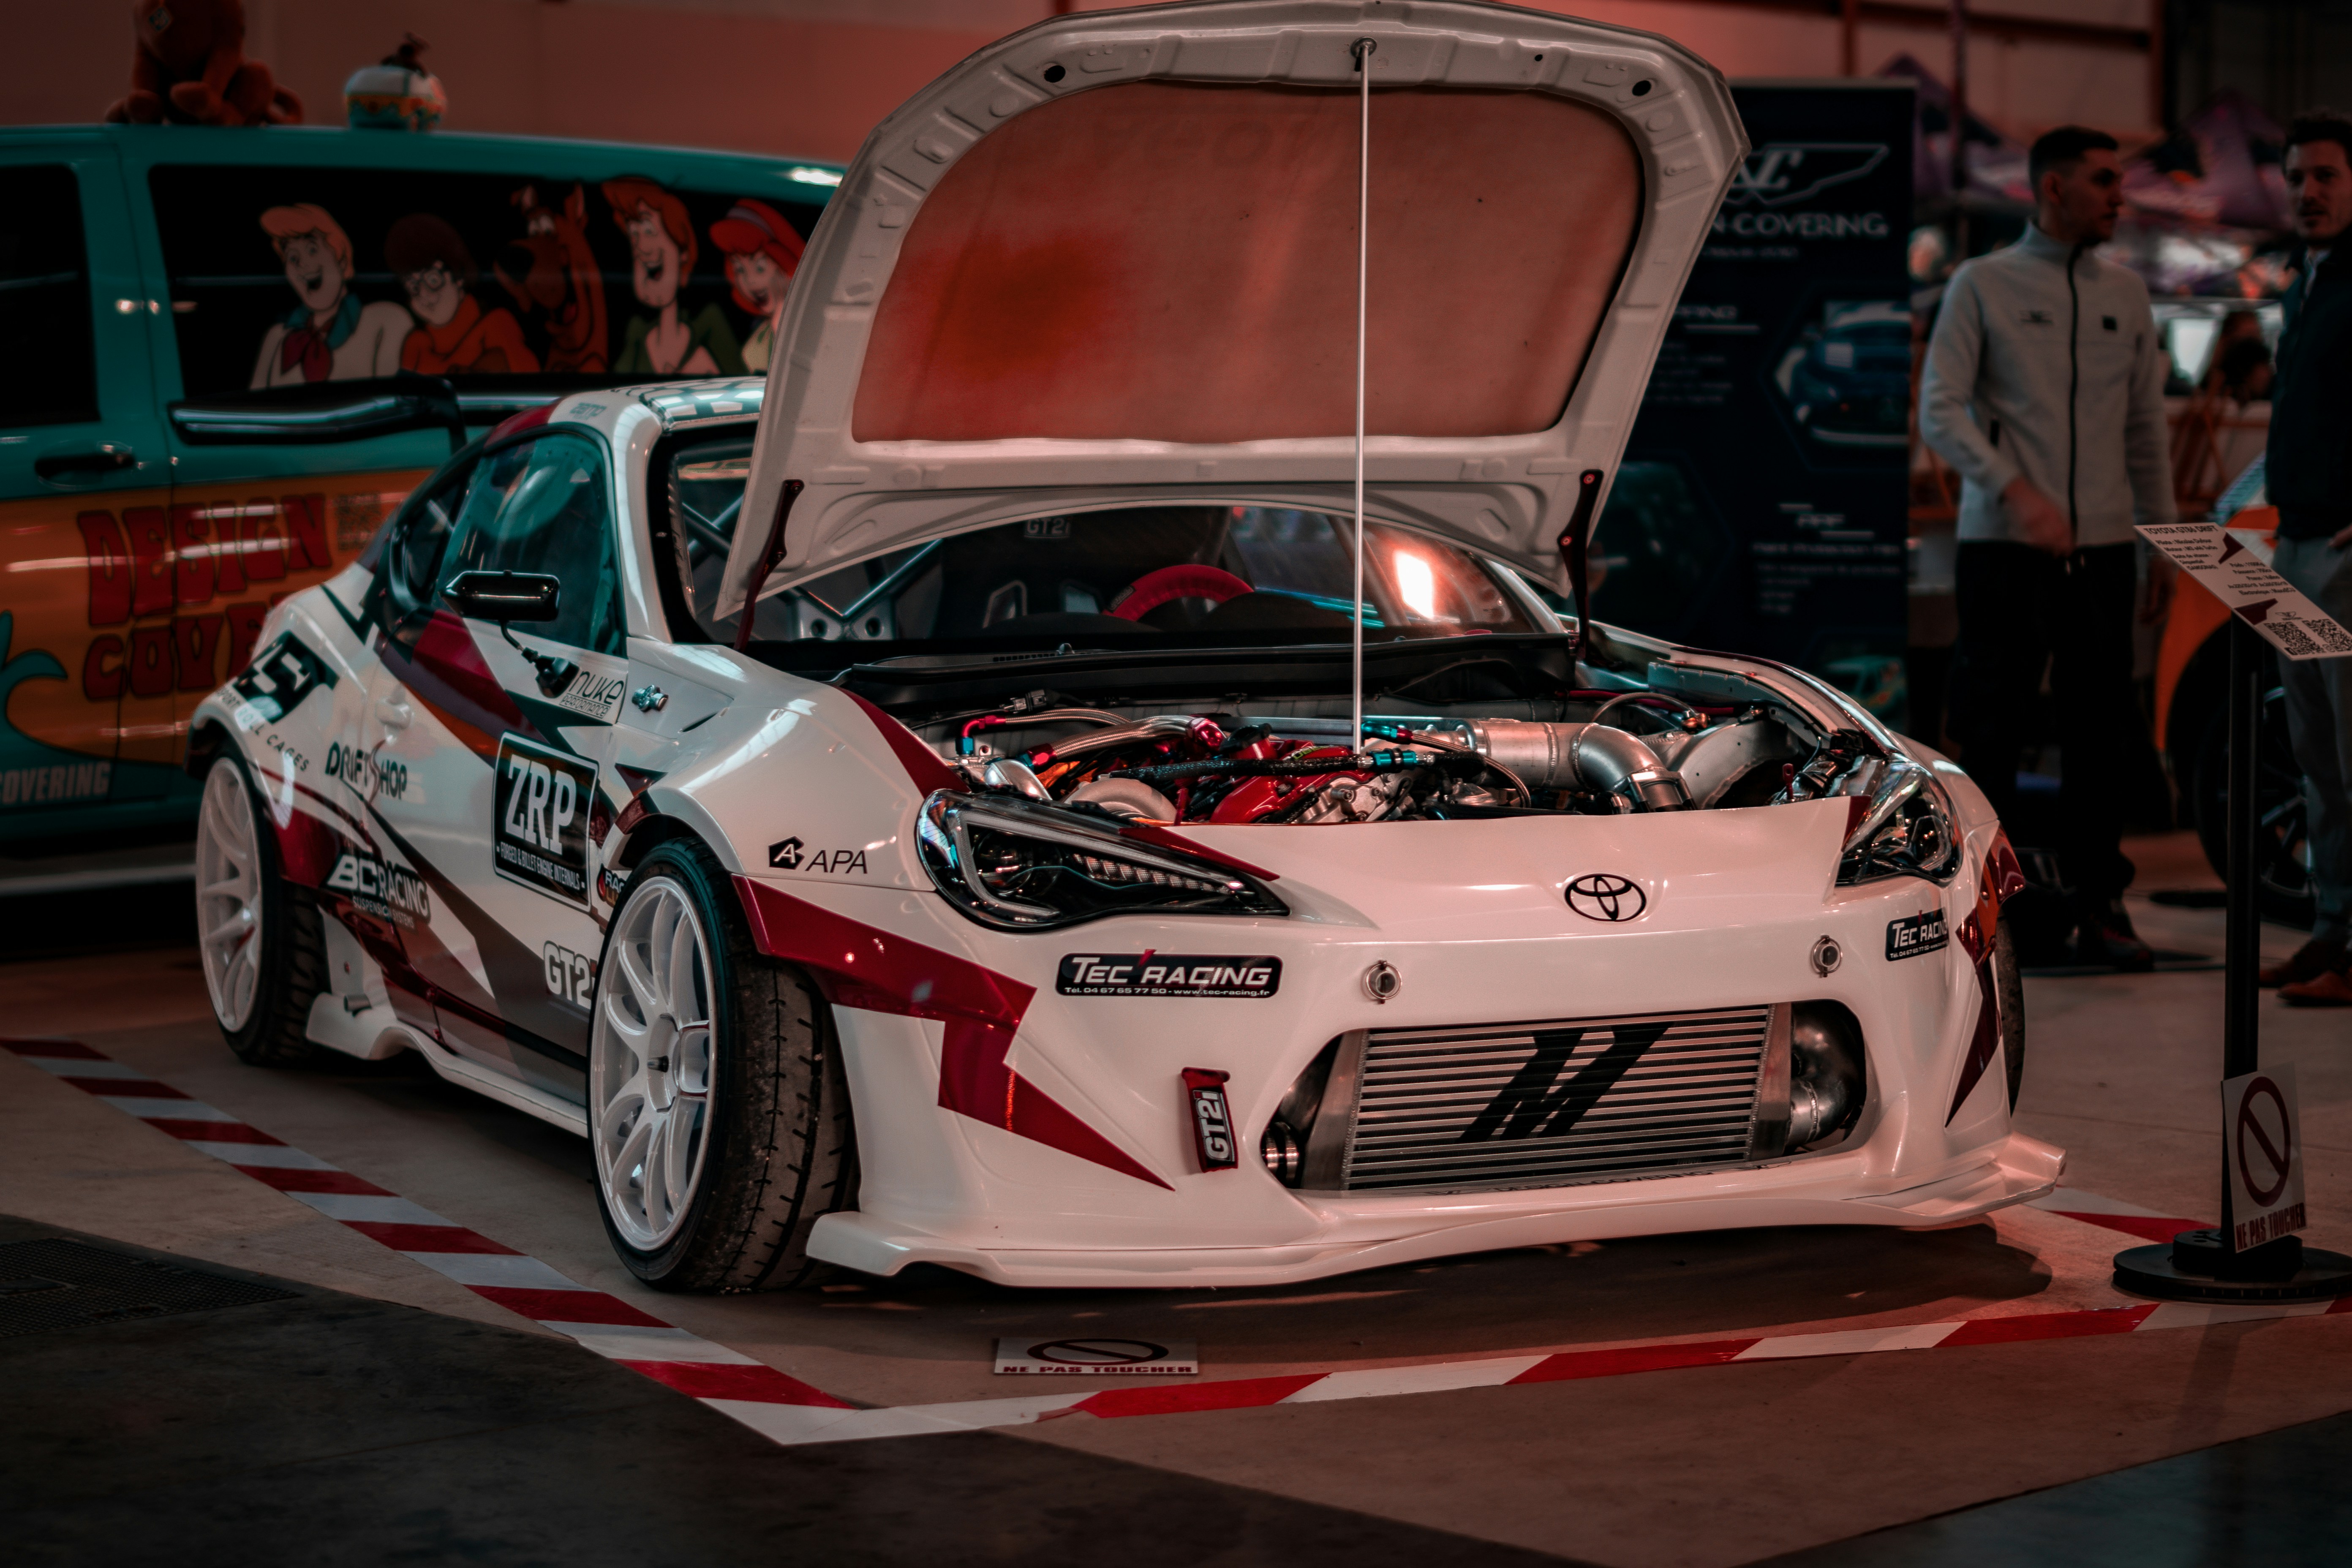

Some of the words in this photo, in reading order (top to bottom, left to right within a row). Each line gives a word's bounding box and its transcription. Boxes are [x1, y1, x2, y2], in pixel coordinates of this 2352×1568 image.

[77, 493, 334, 627] DESIGN
[267, 735, 310, 771] CAGES
[505, 753, 577, 856] ZRP
[327, 854, 378, 896] BC
[378, 864, 428, 917] RACING
[805, 849, 868, 874] APA
[1140, 966, 1272, 985] RACING
[1193, 1090, 1231, 1162] GT2i
[2236, 1223, 2248, 1251] NE
[2249, 1216, 2266, 1246] PAS
[2268, 1203, 2306, 1239] TOUCHER
